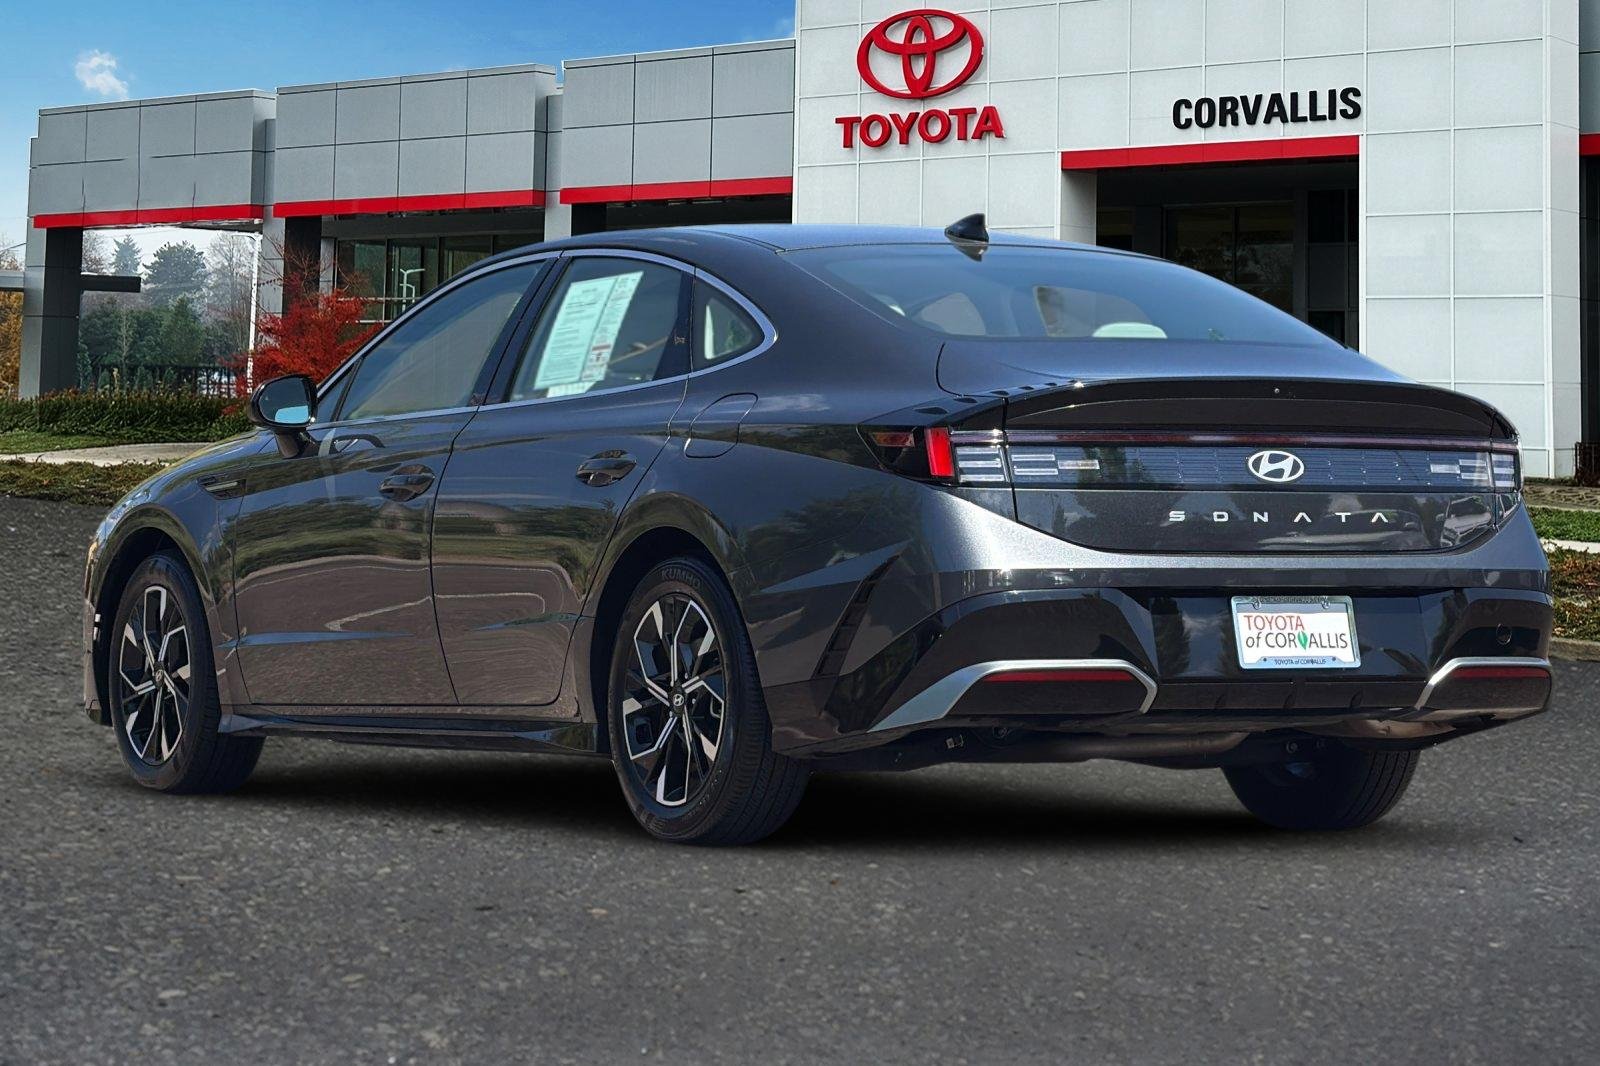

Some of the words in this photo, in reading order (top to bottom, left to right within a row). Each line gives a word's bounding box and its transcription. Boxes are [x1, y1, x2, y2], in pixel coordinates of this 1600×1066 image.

[1172, 87, 1362, 129] CORVALLIS
[835, 105, 1006, 148] TOYOTA
[1168, 510, 1389, 523] SONATA
[661, 568, 701, 588] KUMHO
[1243, 615, 1305, 631] TOYOTA
[1245, 632, 1262, 648] of
